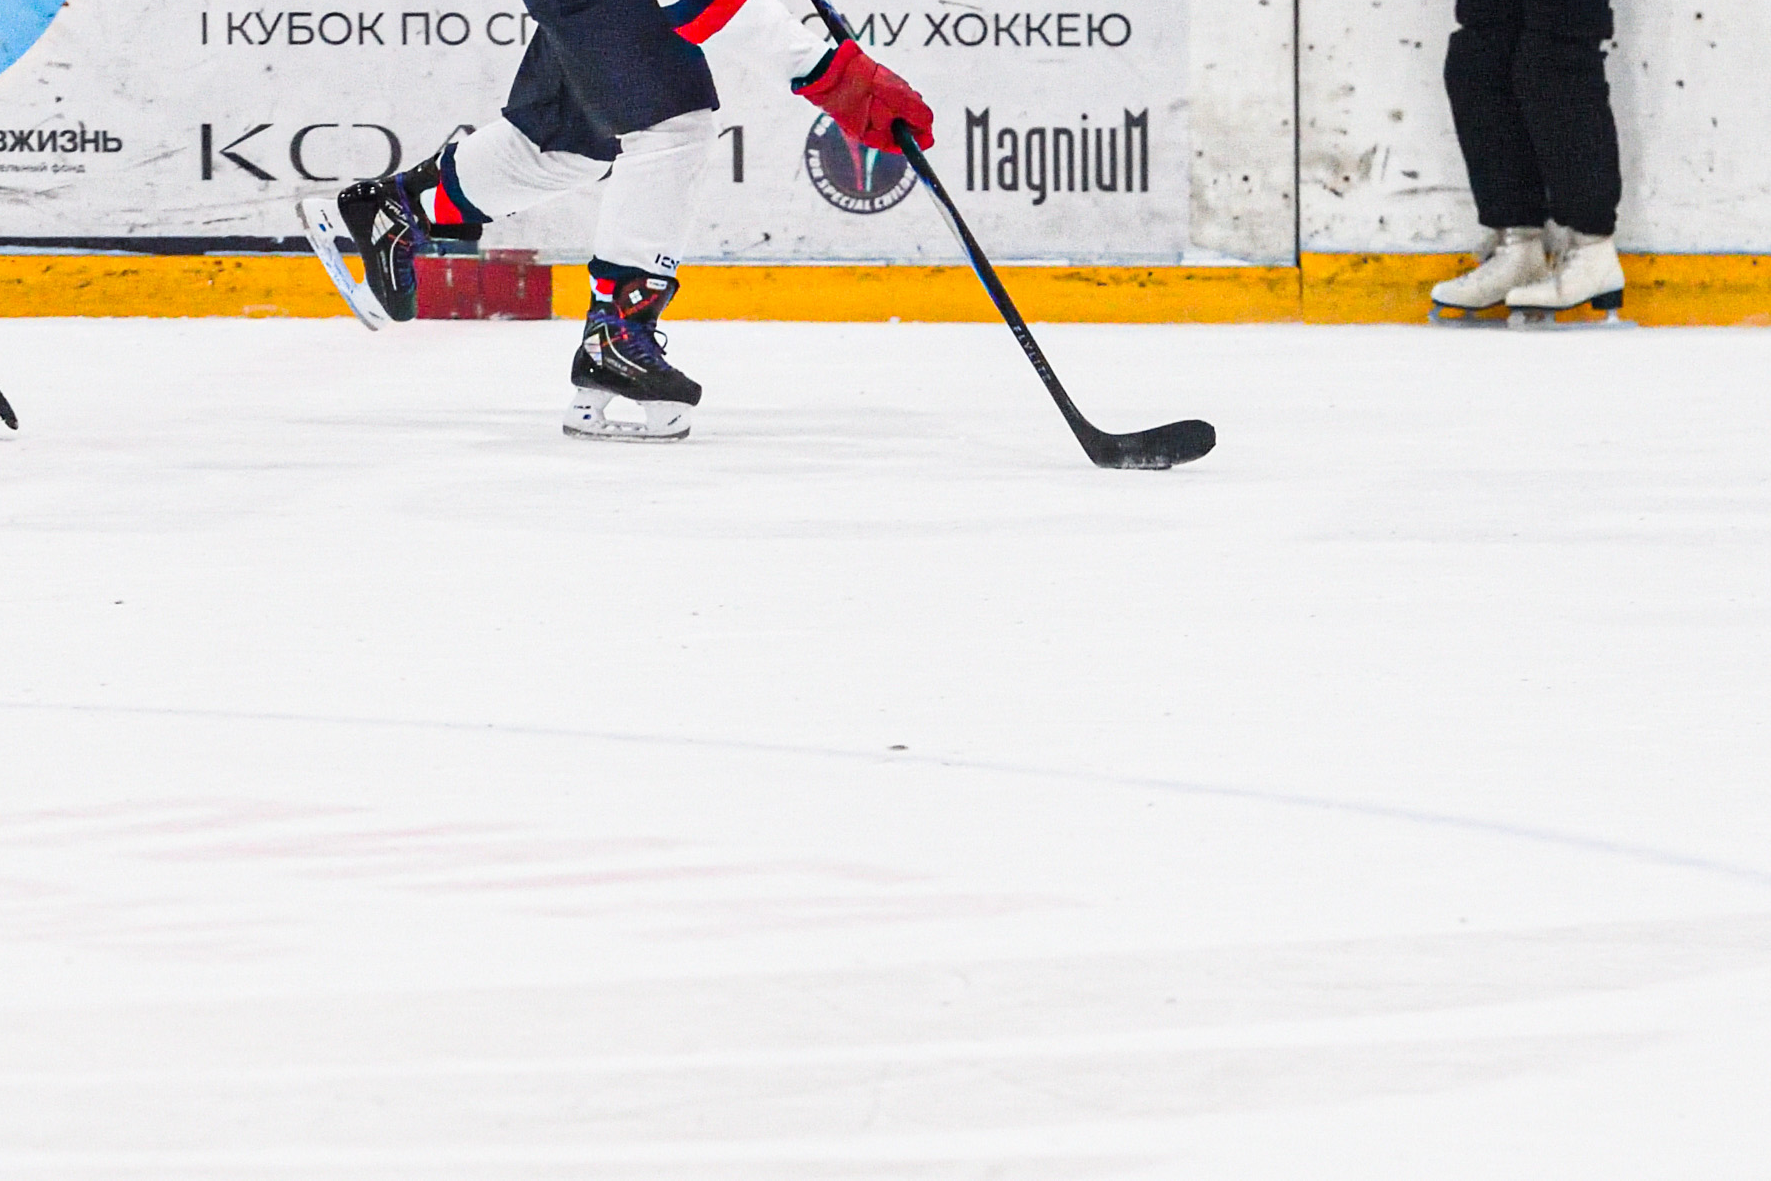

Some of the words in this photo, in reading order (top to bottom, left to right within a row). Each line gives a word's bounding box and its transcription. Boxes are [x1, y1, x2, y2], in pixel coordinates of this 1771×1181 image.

[227, 11, 384, 45] КУБОК
[402, 11, 470, 45] ПО
[924, 12, 1132, 47] ХОККЕЮ
[816, 178, 872, 210] SPECIAL
